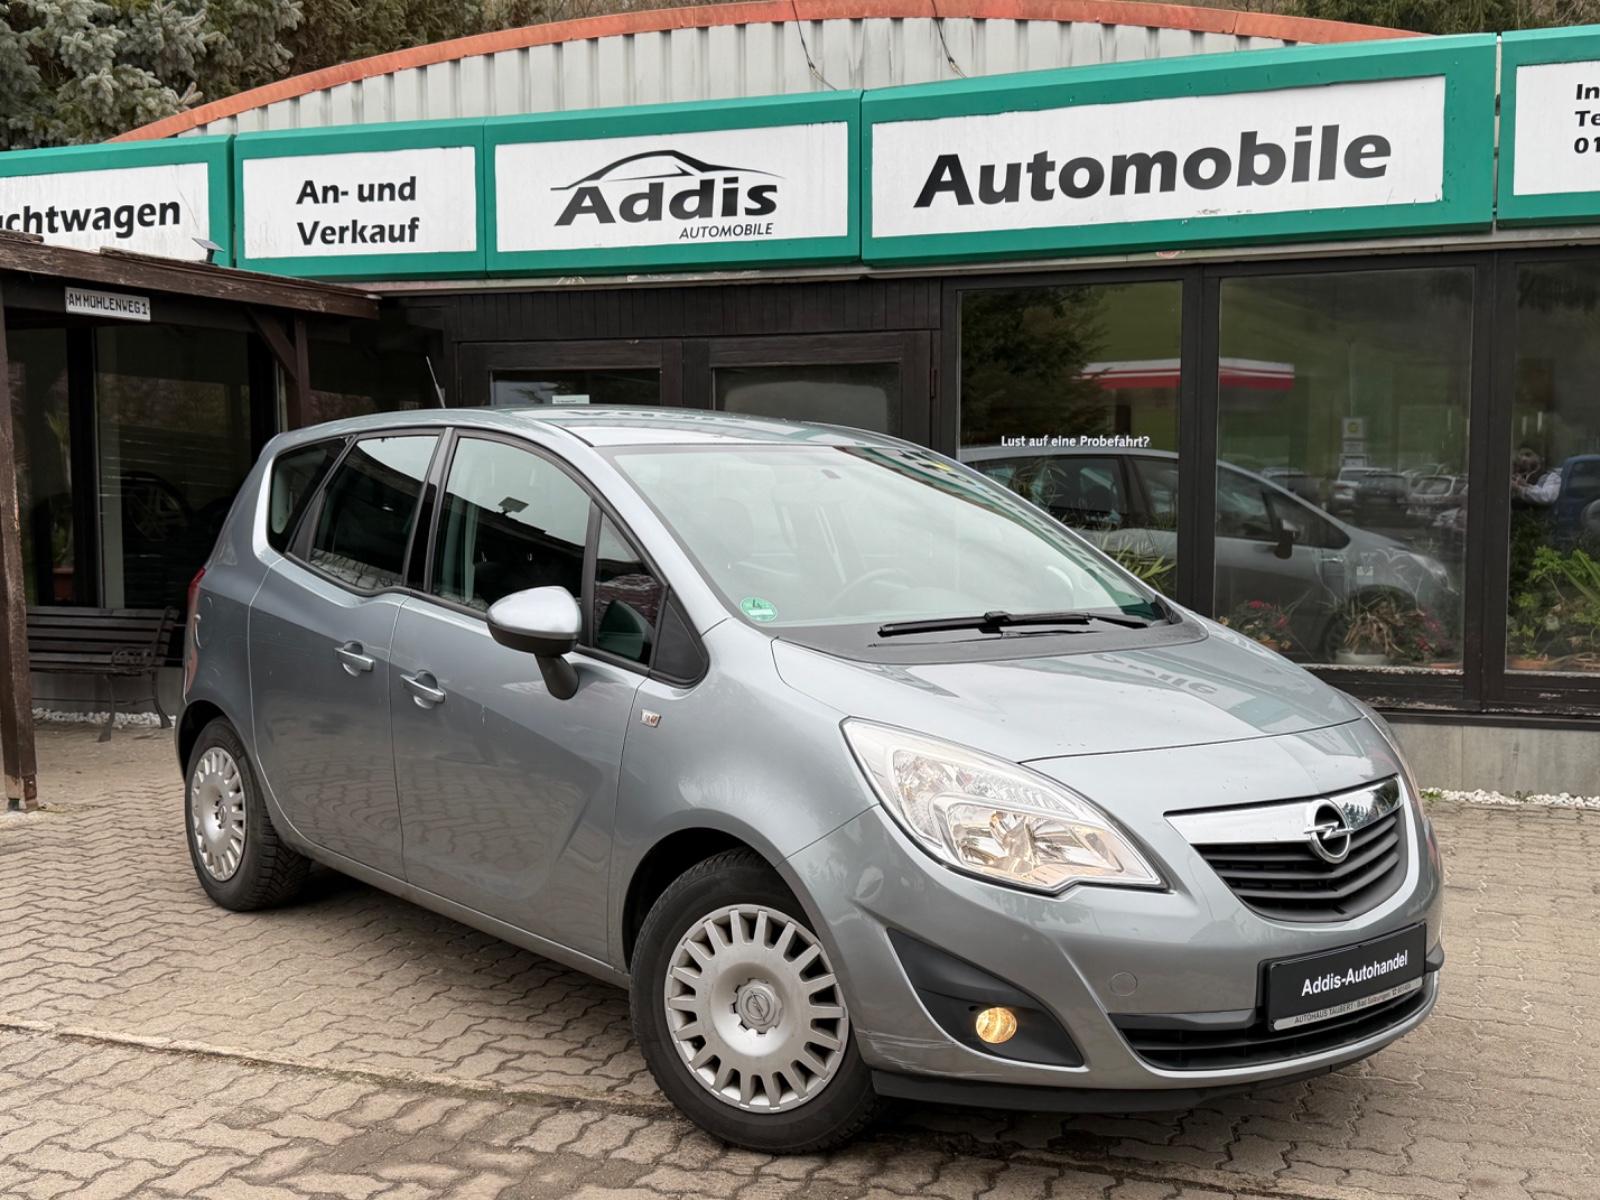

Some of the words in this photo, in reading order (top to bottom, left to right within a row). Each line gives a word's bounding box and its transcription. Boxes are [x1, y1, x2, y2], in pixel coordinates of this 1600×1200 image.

[913, 124, 1392, 209] Automobile
[296, 180, 349, 205] An-
[357, 175, 417, 203] und
[554, 176, 778, 227] Addis
[0, 201, 181, 239] chtwagen
[296, 216, 420, 246] Verkauf
[679, 222, 774, 239] AUTOMOBILE
[141, 303, 148, 315] 1
[1001, 435, 1026, 447] Lust
[1029, 434, 1048, 447] auf
[1051, 435, 1076, 447] eine
[1080, 434, 1150, 448] Probefahrt?
[1301, 949, 1408, 997] Addis-Autohandel
